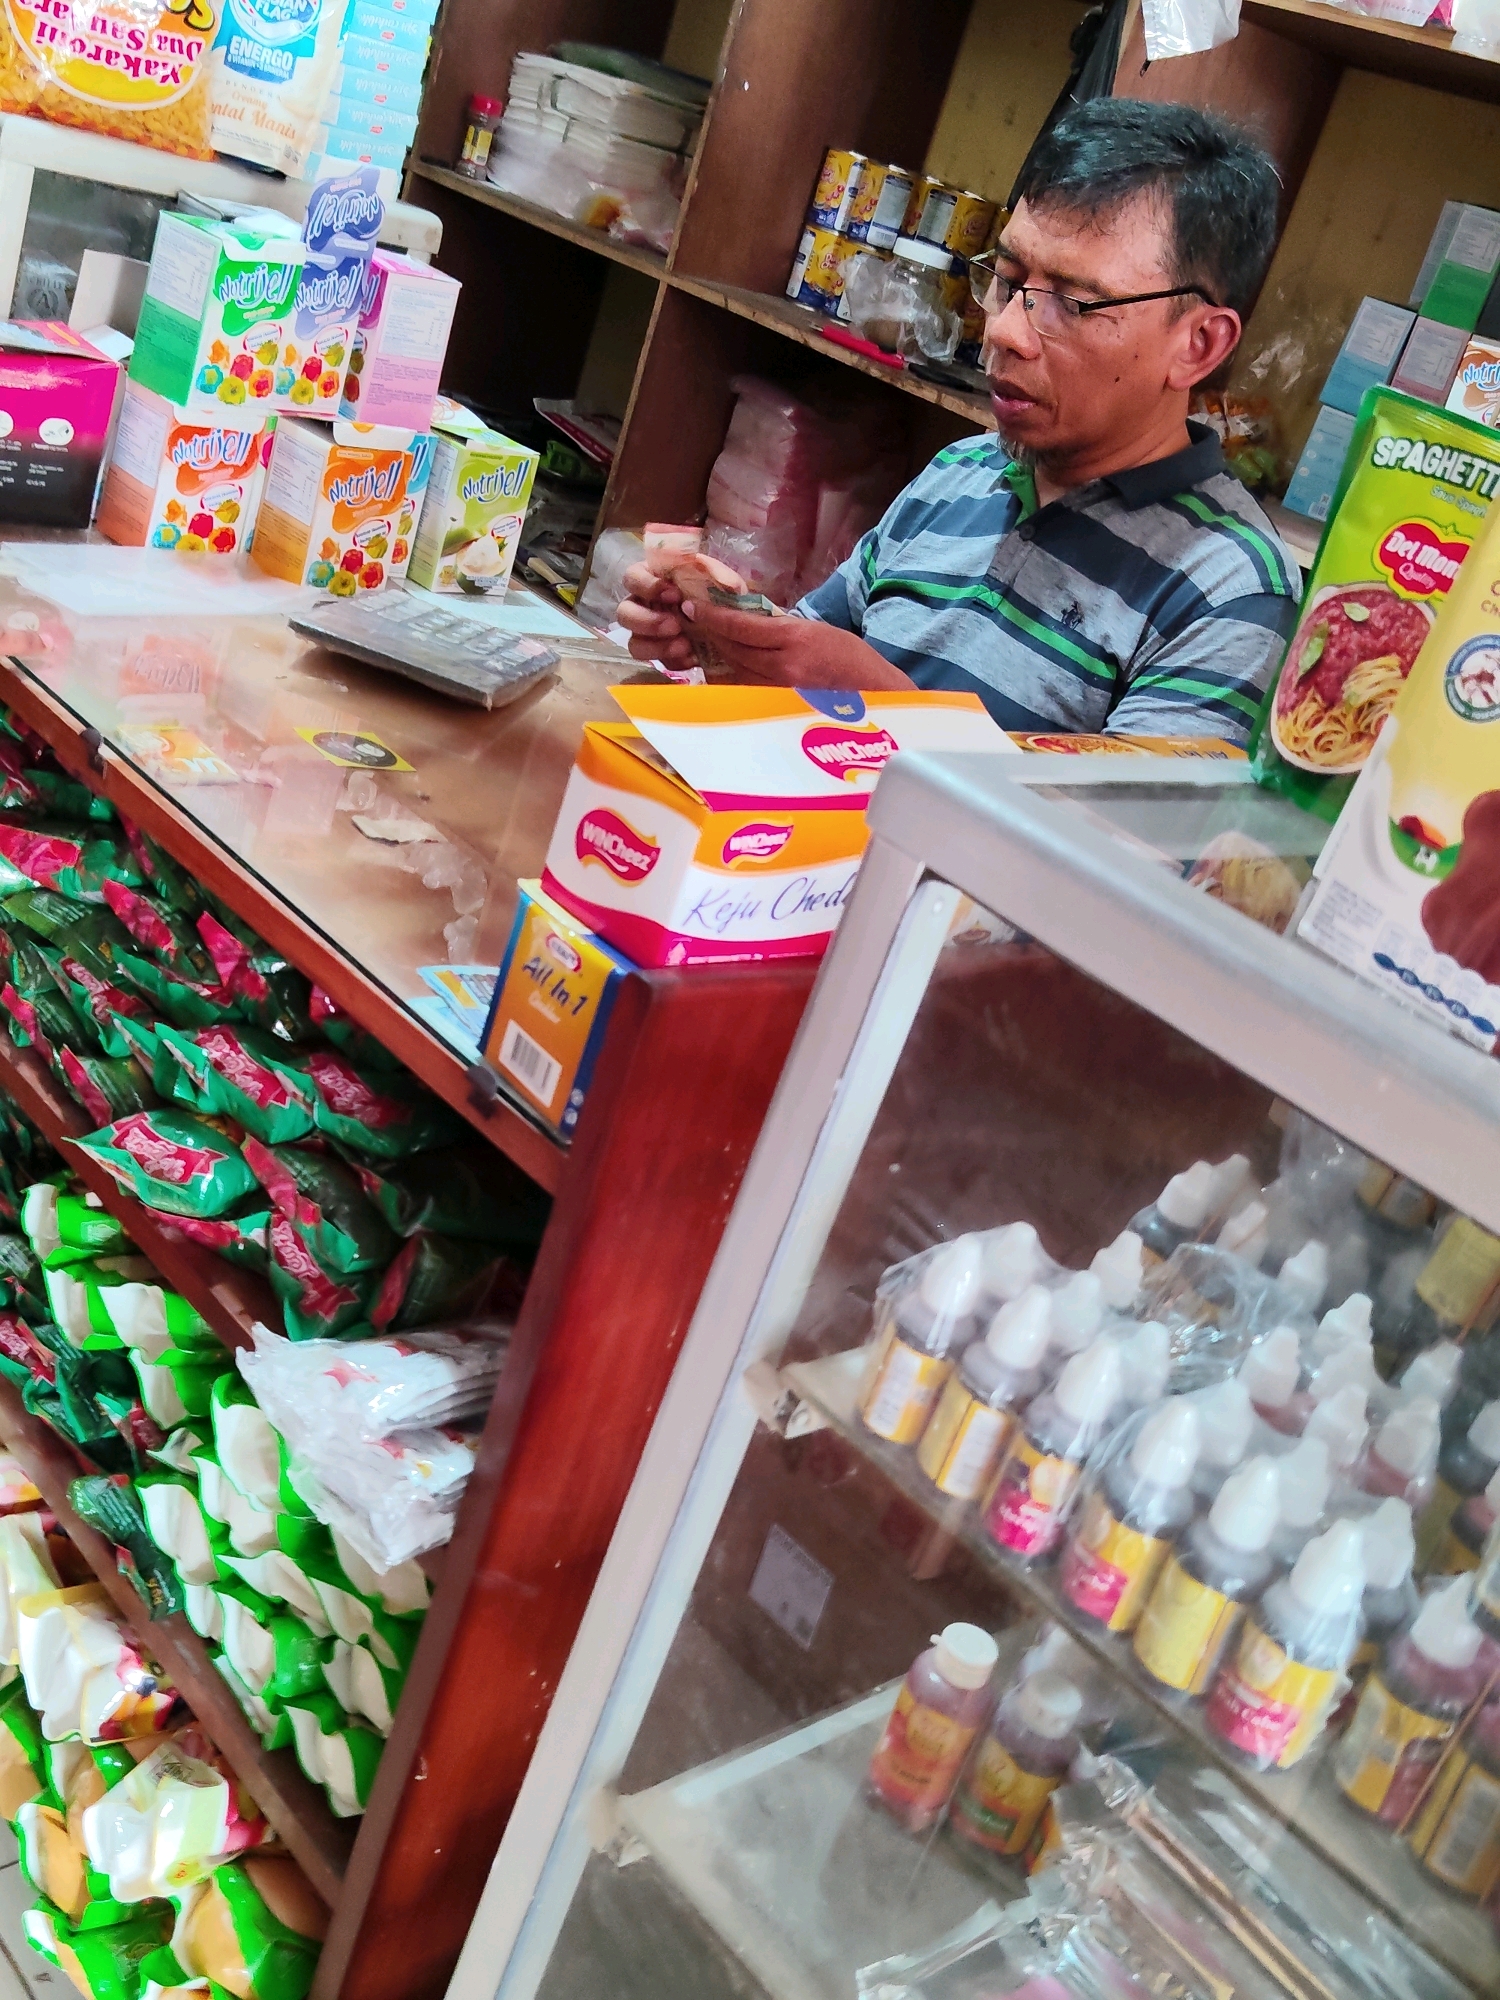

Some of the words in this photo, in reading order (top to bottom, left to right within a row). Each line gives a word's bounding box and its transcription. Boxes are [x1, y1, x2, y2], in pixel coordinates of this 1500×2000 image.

[229, 35, 294, 71] ENERGO
[252, 110, 296, 140] Manis
[308, 190, 379, 240] Nutrijell
[219, 263, 296, 309] Nutrijell
[295, 262, 363, 315] Nutrijell
[174, 428, 252, 469] Nutrijell
[329, 460, 403, 506] Nutrijell
[463, 459, 530, 503] Nutrijell
[1385, 530, 1421, 561] Del
[581, 819, 652, 872] WINCheez
[683, 889, 762, 933] Keju
